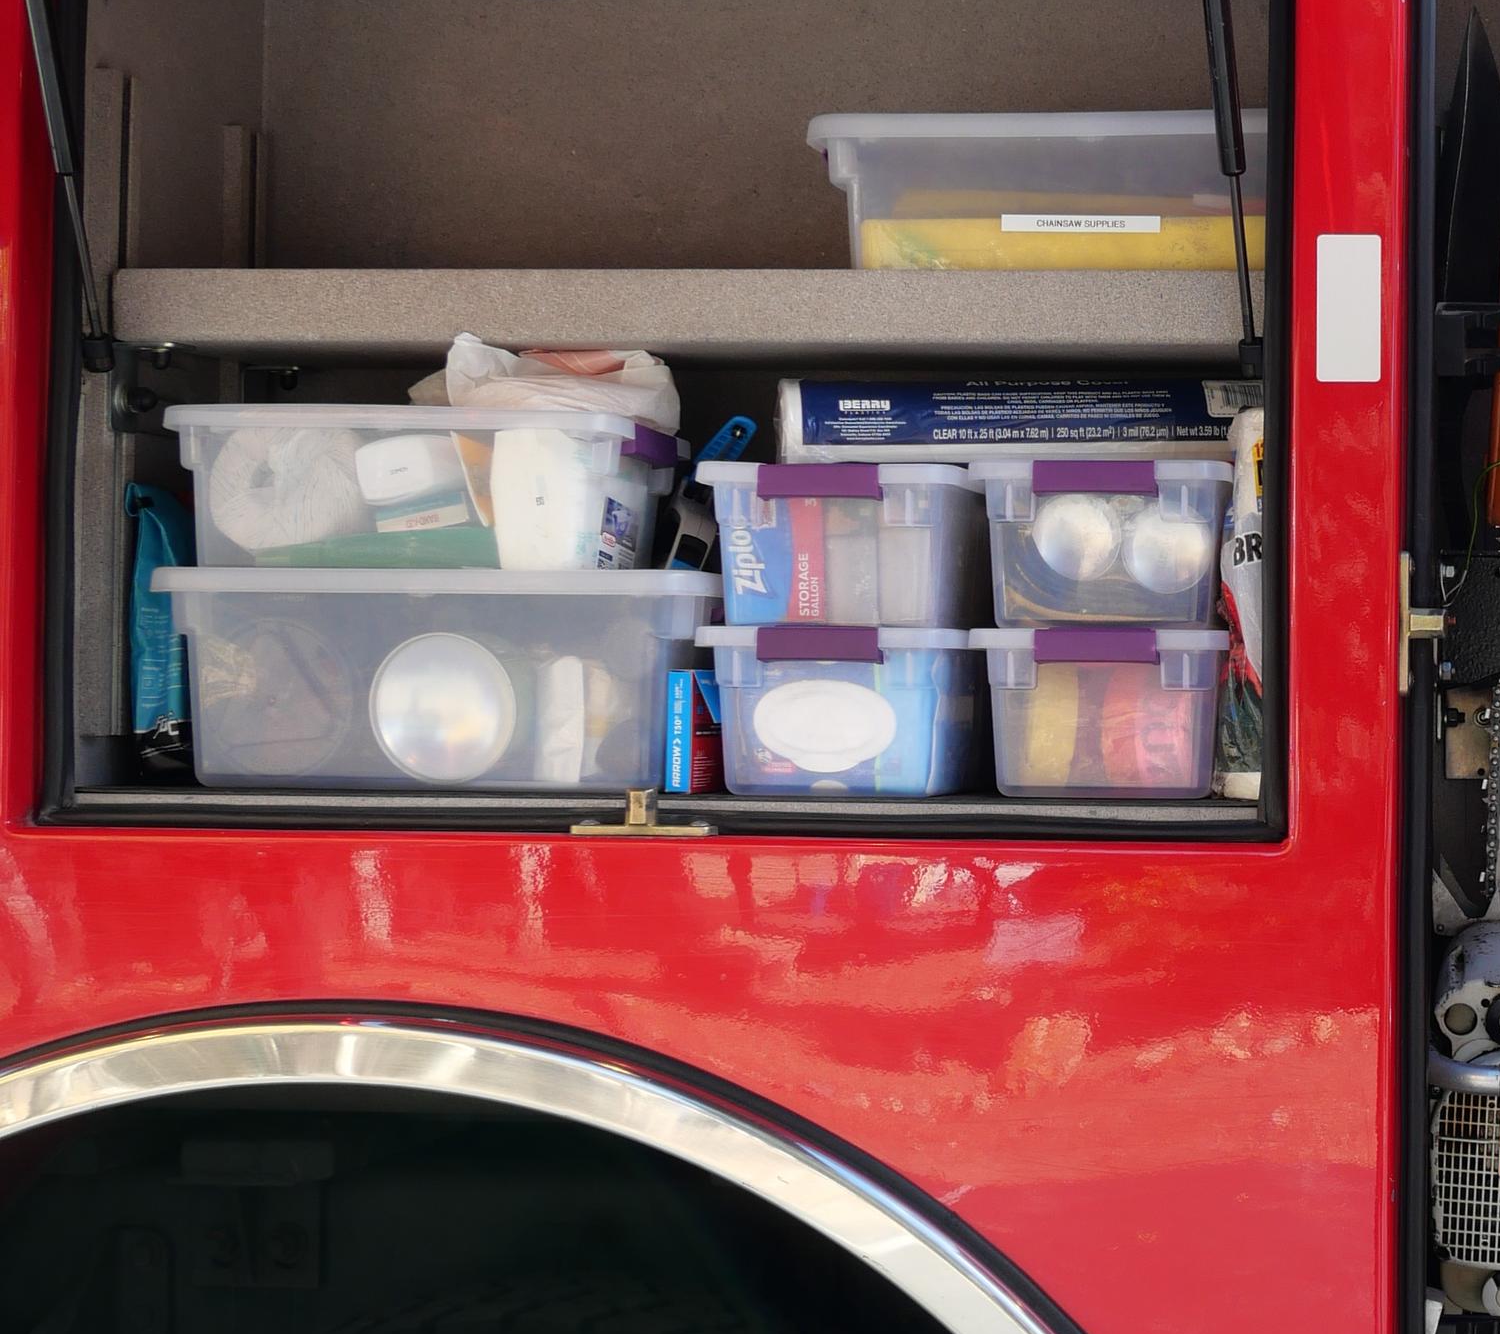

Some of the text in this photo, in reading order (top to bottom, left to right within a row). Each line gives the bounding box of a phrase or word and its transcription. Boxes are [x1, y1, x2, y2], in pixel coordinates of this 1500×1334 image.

[1036, 219, 1126, 228] CHAINSAW SUPPLIES
[839, 400, 891, 412] BERRY
[932, 428, 957, 440] CLEAR
[958, 428, 966, 439] 10
[967, 428, 972, 439] ft
[978, 428, 987, 439] 25
[988, 428, 993, 439] ft
[995, 427, 1010, 440] (3.04
[1012, 430, 1018, 438] m
[1020, 430, 1024, 438] x
[1025, 427, 1039, 438] 7.62
[1039, 426, 1048, 440] m)
[1056, 427, 1068, 438] 250
[1069, 429, 1078, 439] sq
[1079, 426, 1085, 437] ft
[1086, 426, 1101, 439] (23.2
[1122, 426, 1127, 436] 3
[1128, 426, 1138, 436] mil
[1139, 426, 1155, 438] (76.2
[1176, 426, 1188, 436] Net
[1189, 426, 1197, 436] wt
[1198, 425, 1211, 436] 3.59
[1213, 425, 1219, 436] lb
[799, 553, 810, 616] STORAGE
[811, 576, 820, 616] GALLON
[672, 747, 682, 787] ARROW
